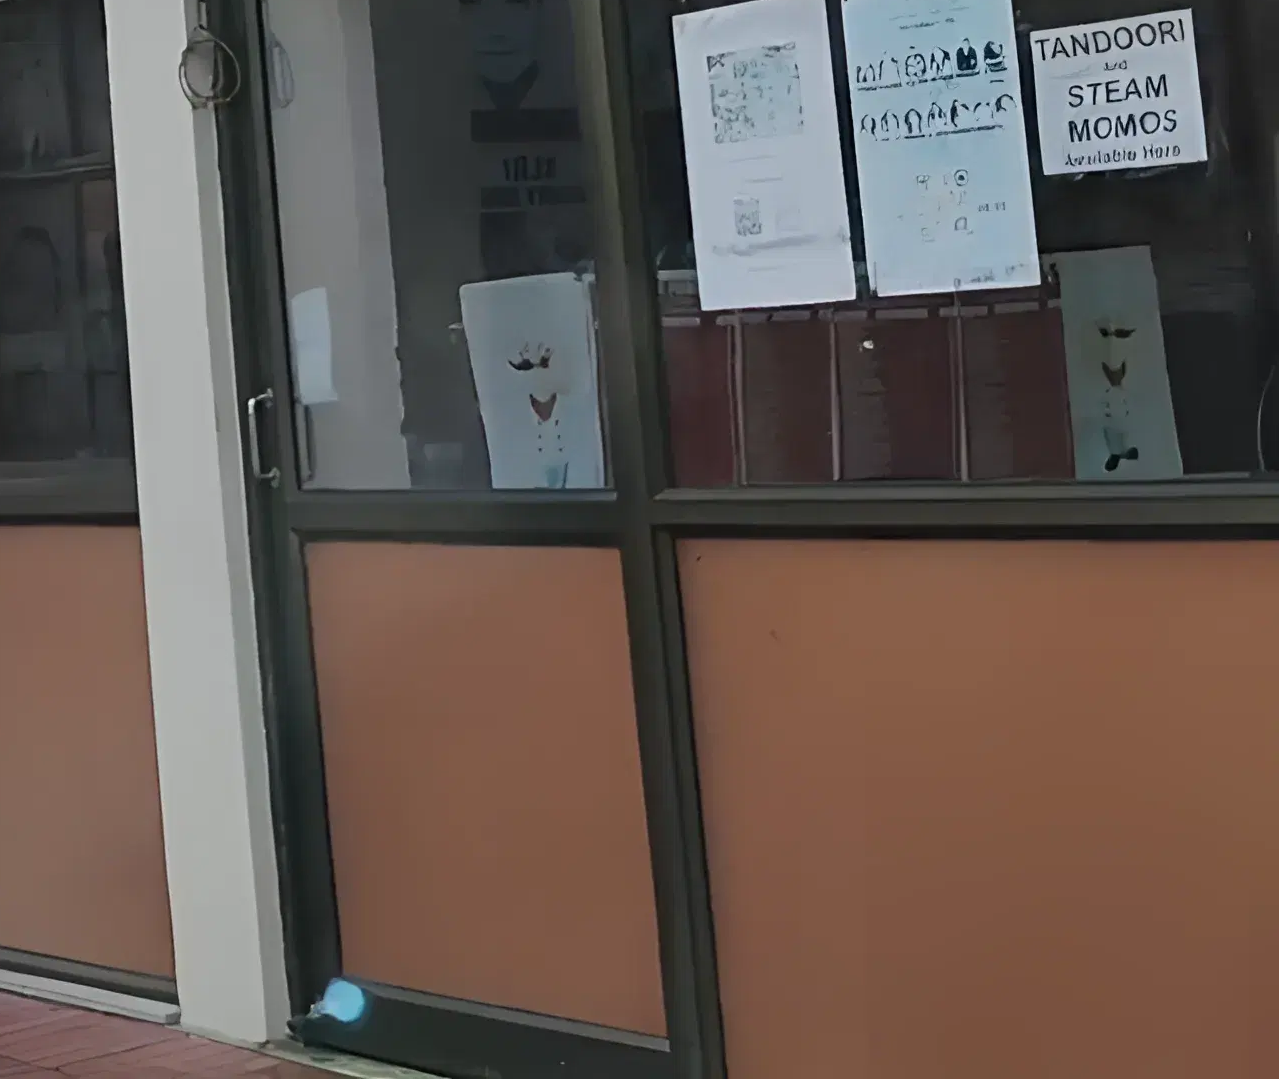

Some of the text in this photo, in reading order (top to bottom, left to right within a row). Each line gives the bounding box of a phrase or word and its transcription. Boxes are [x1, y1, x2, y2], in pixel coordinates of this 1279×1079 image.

[1034, 18, 1185, 61] TANDOORI
[1068, 74, 1169, 108] STEAM
[1068, 109, 1178, 143] MOMOS
